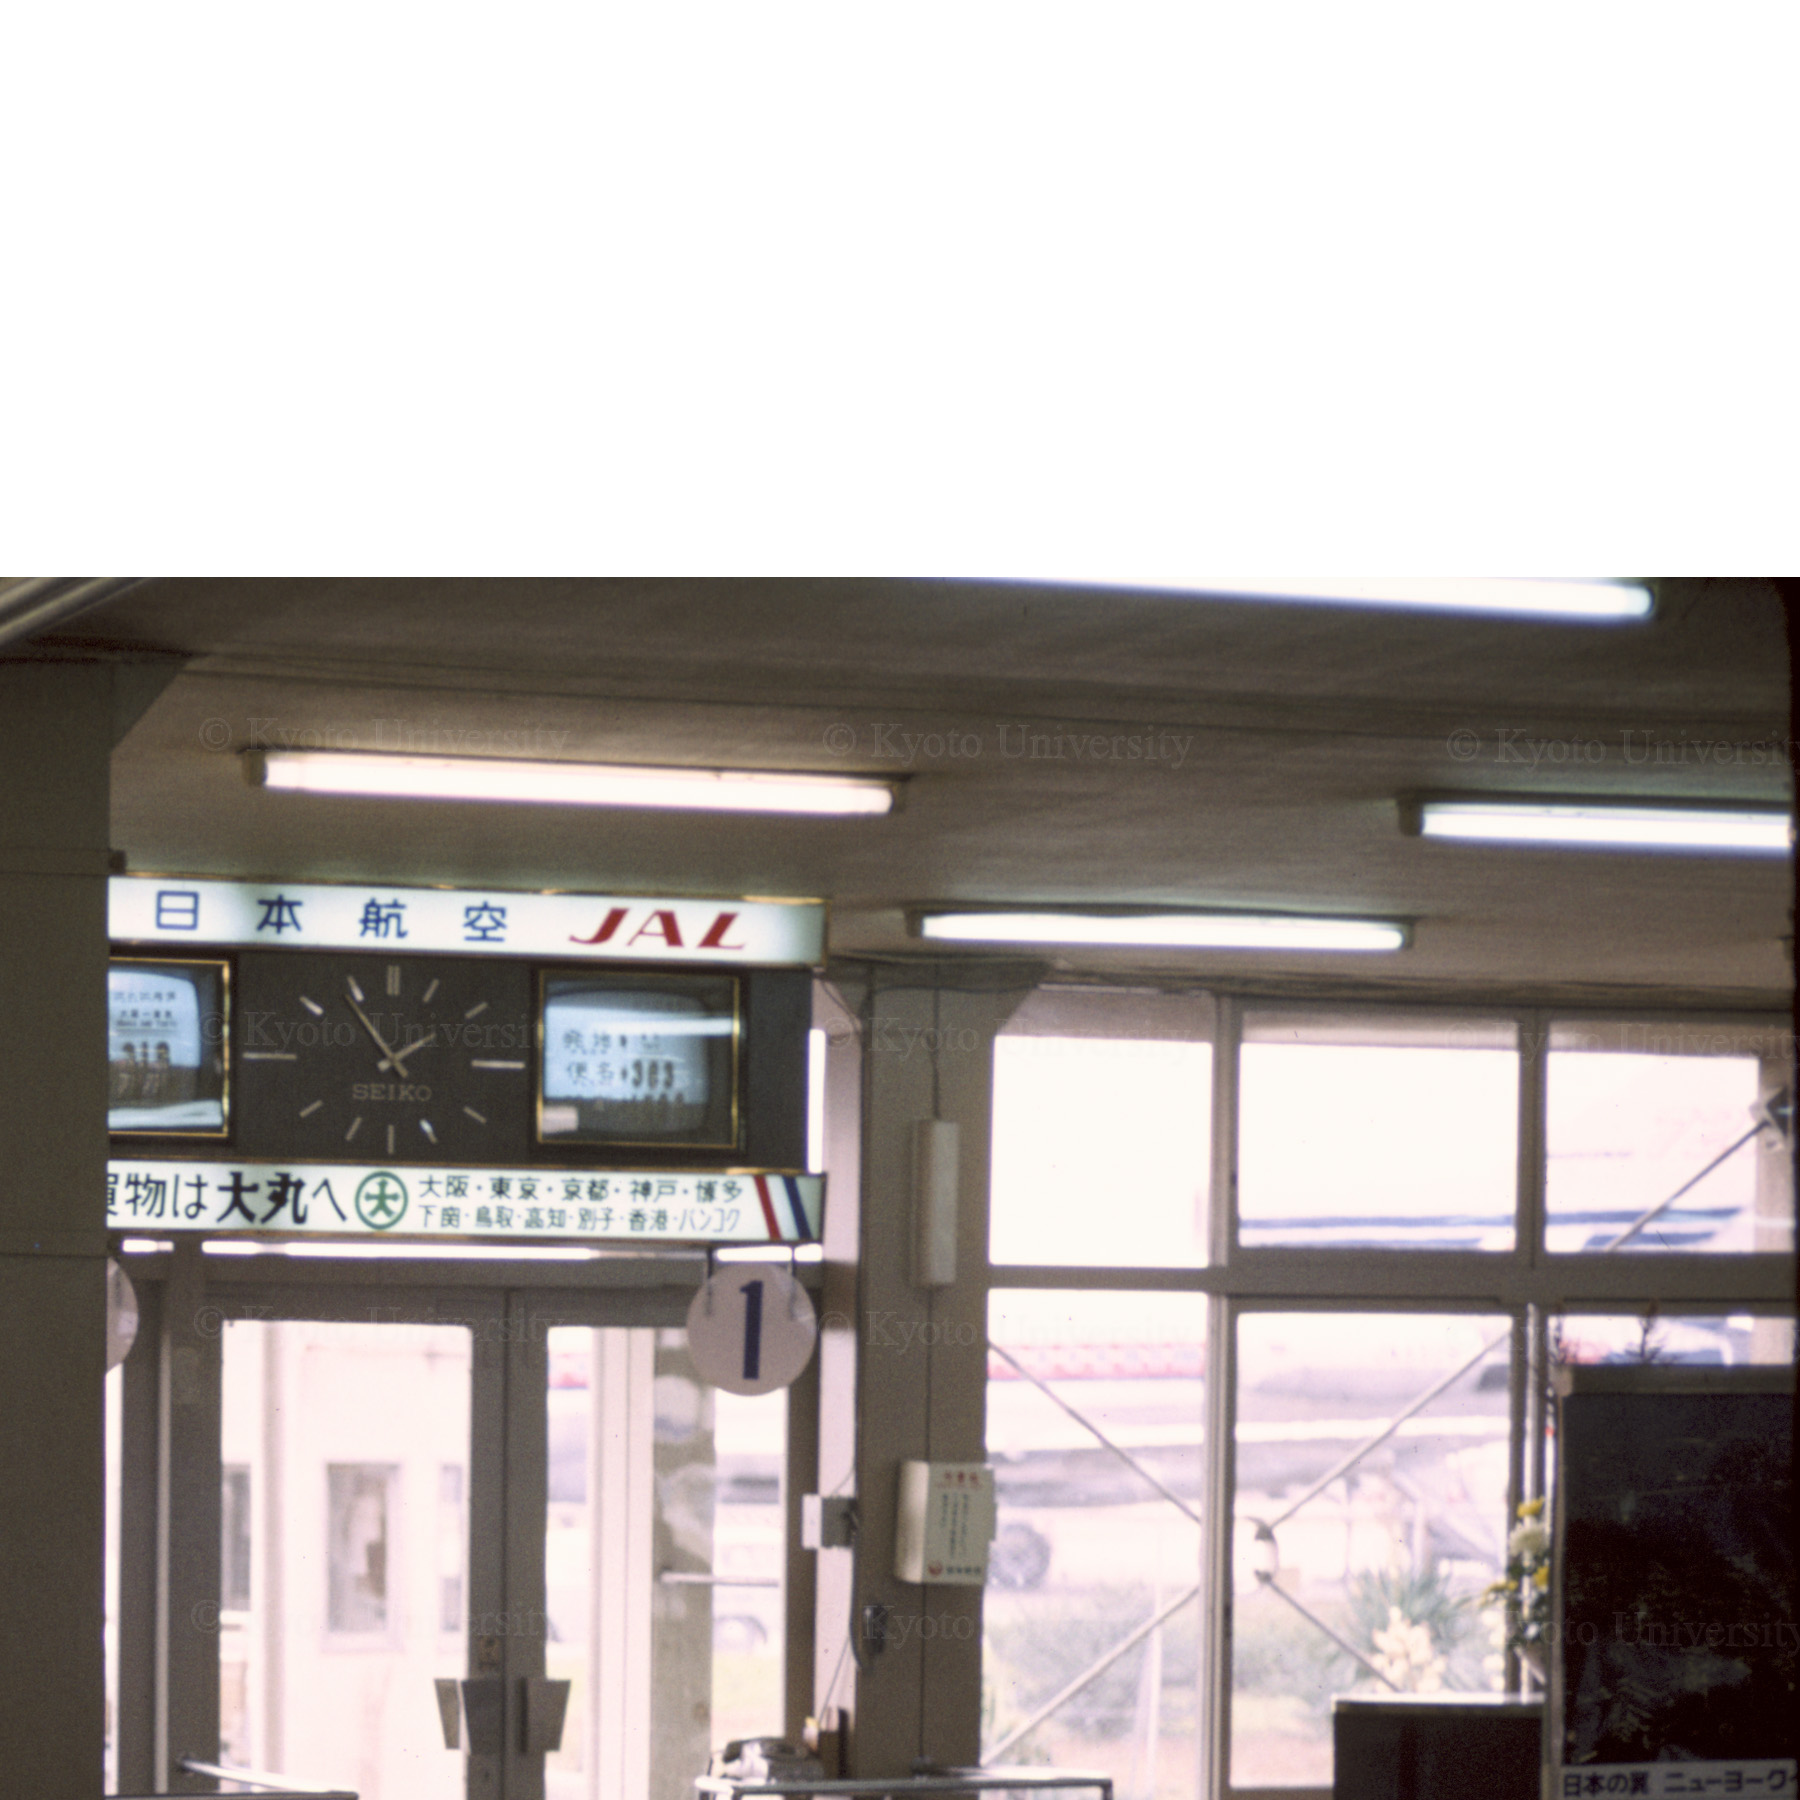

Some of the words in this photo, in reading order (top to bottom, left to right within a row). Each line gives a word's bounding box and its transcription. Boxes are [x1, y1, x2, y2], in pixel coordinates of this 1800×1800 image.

[155, 890, 507, 942] 日本航空
[568, 908, 746, 949] JAL
[352, 1083, 432, 1101] SEIKO
[740, 1280, 763, 1380] 1
[1664, 1769, 1797, 1794] ニューヨーク
